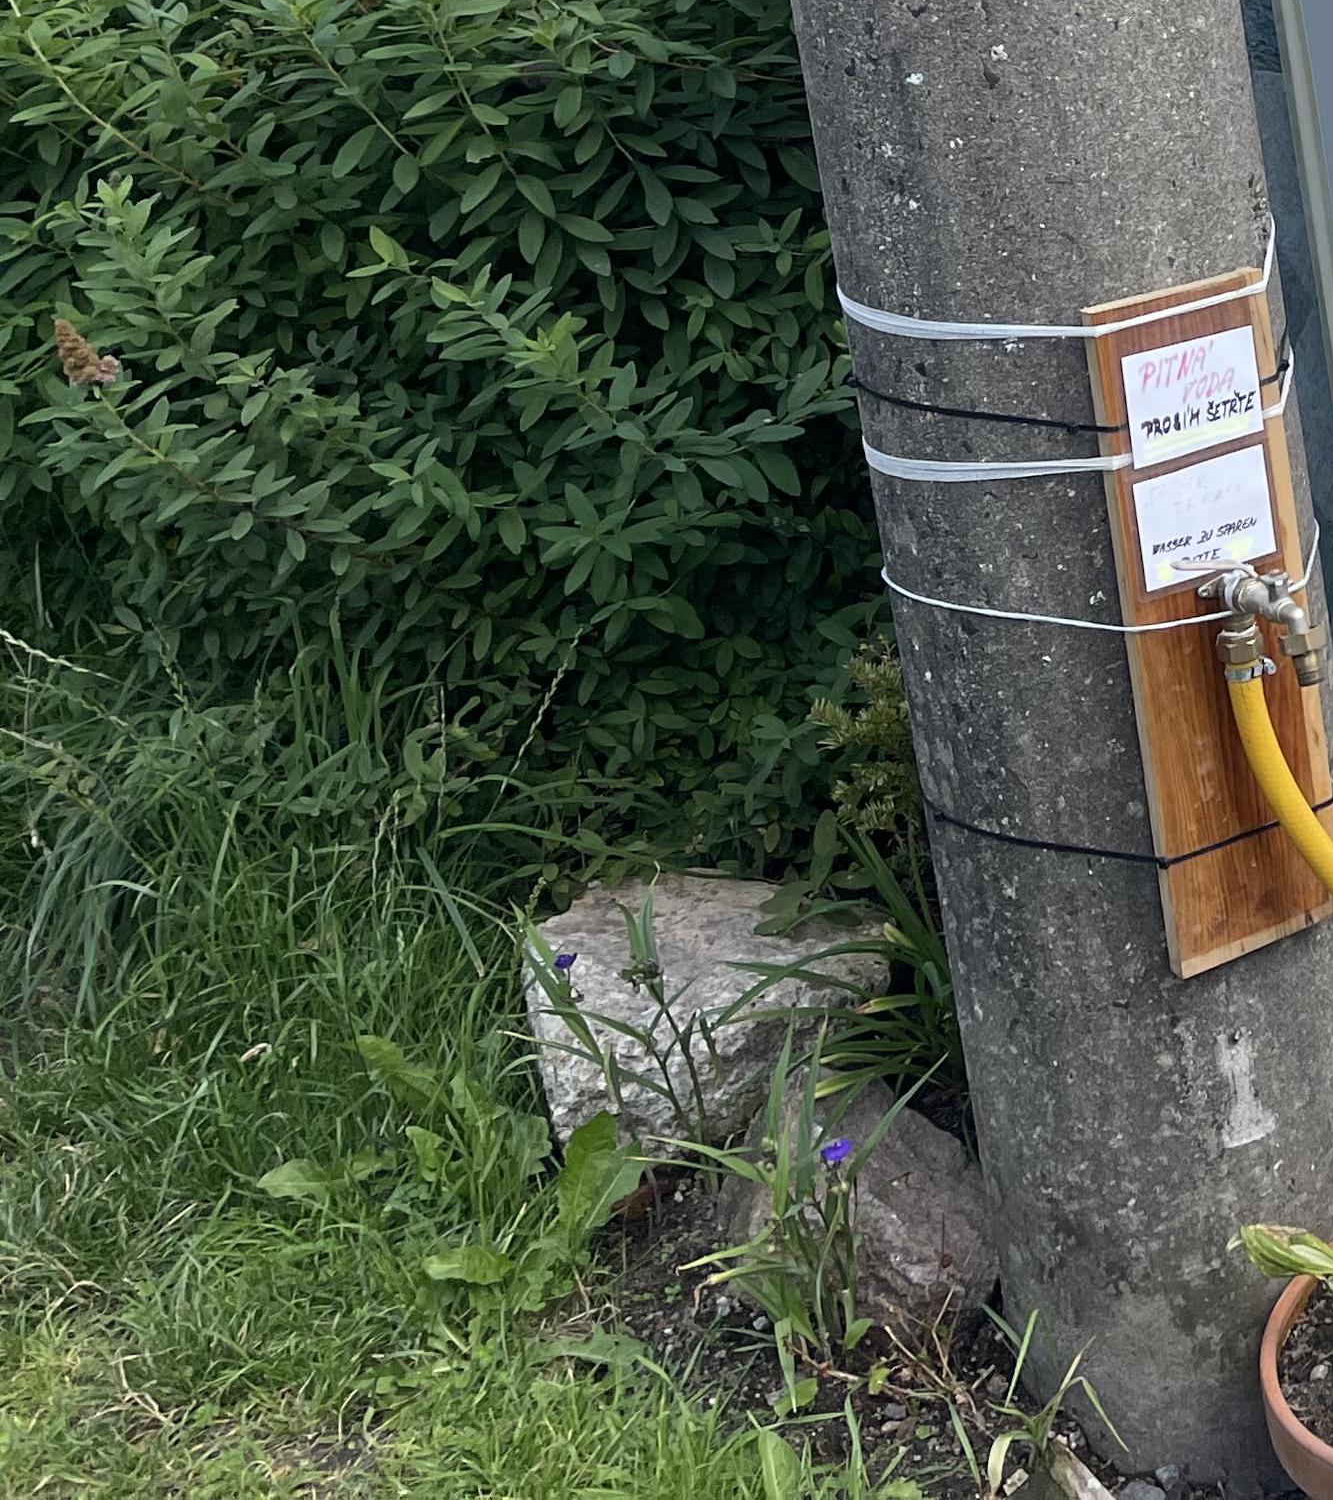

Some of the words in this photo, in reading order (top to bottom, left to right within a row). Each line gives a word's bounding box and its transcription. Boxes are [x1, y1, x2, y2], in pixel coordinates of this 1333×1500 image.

[1139, 340, 1214, 393] PITNÁ
[1182, 367, 1236, 404] VODA
[1152, 535, 1193, 556] WASSER
